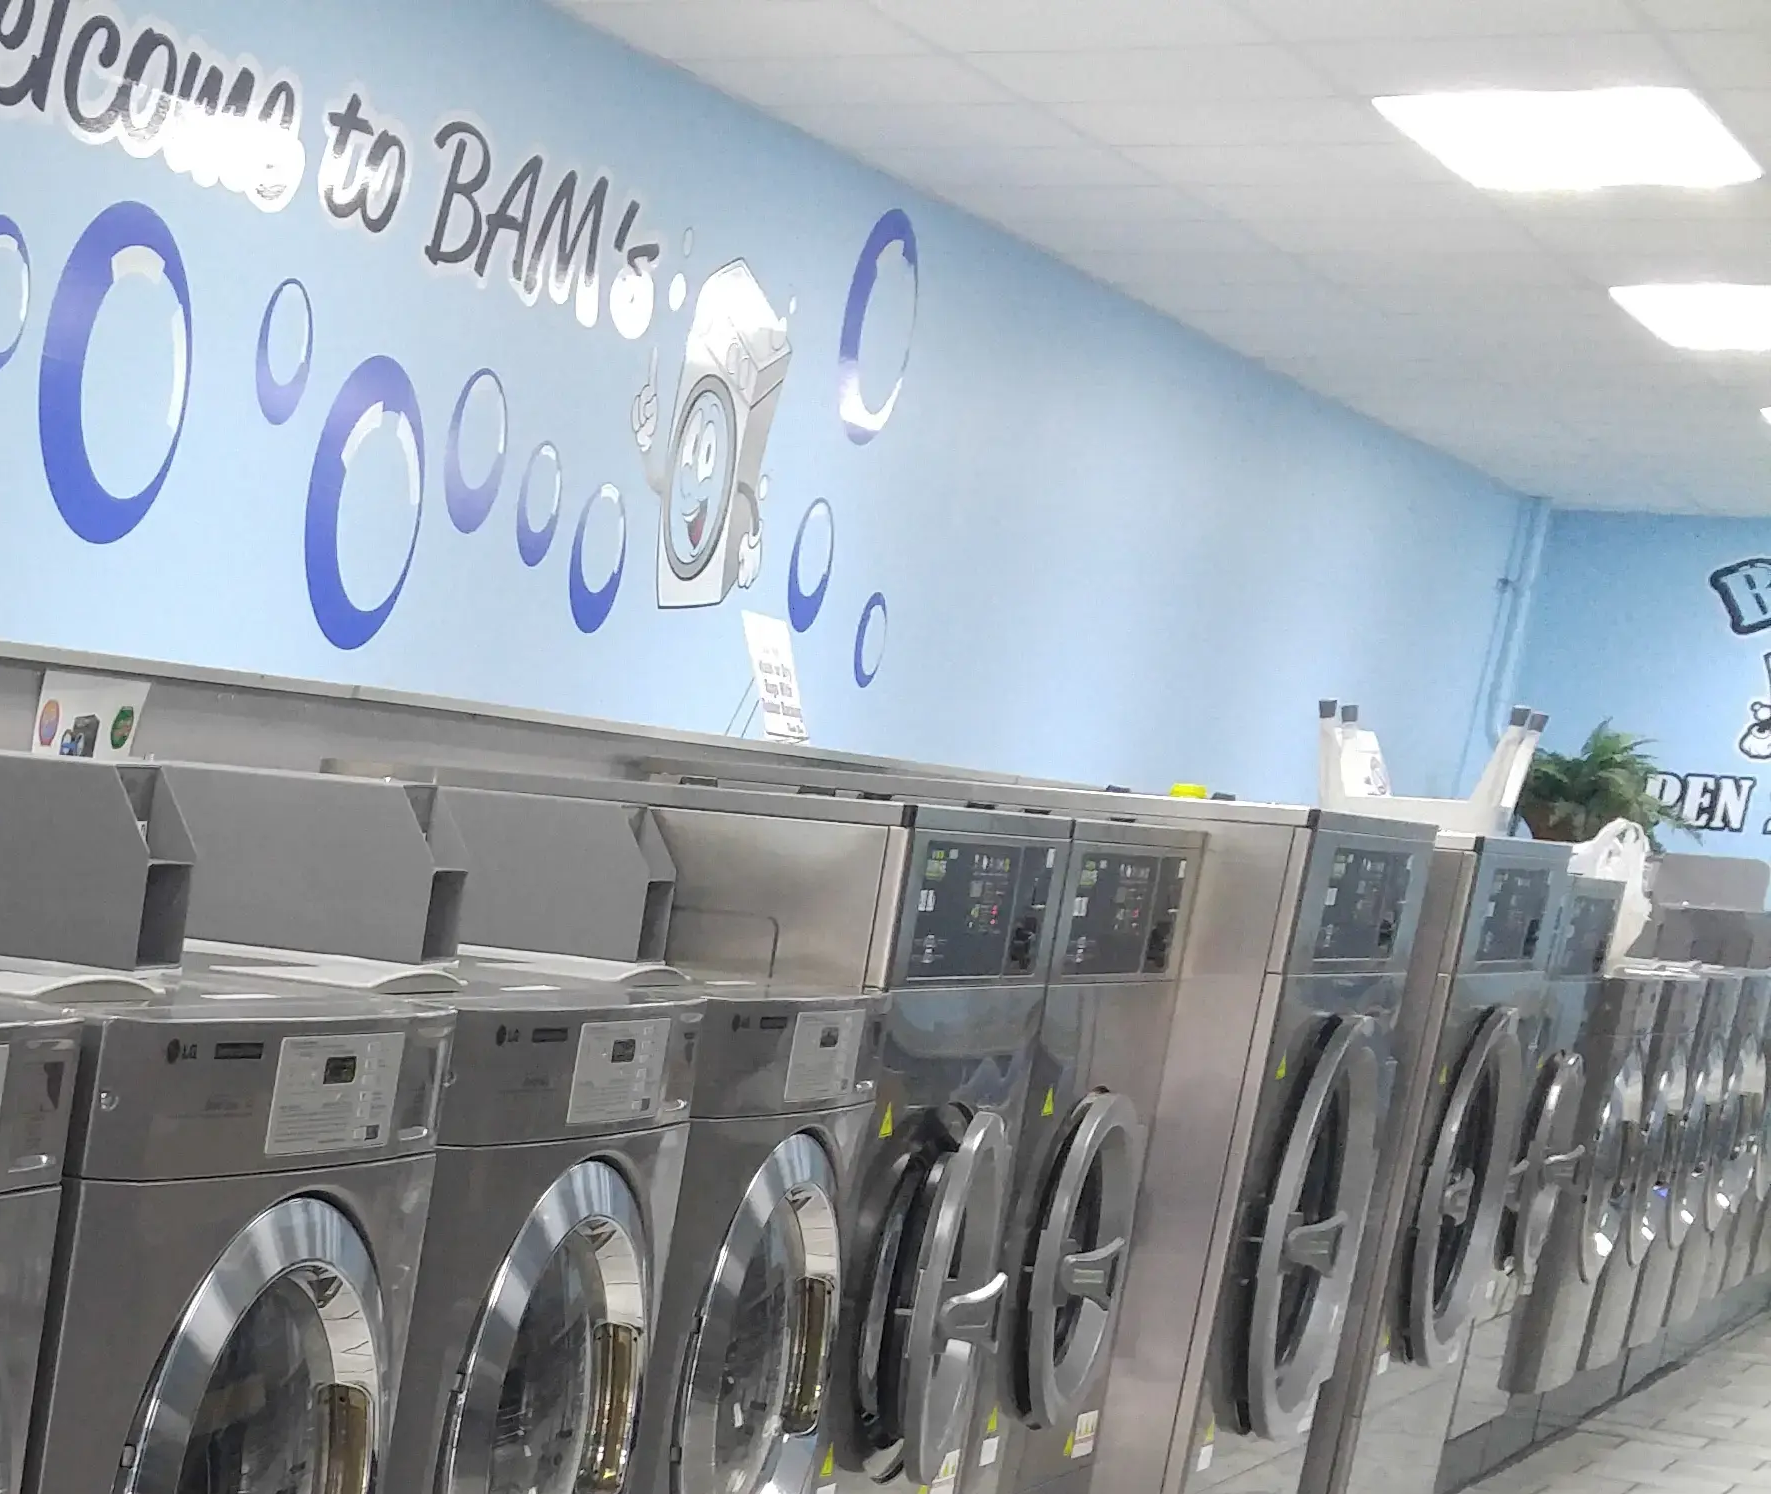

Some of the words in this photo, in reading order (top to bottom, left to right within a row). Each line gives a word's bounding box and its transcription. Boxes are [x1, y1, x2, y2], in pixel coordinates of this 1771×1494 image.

[322, 93, 408, 234] to
[424, 121, 661, 302] BAM's
[1645, 771, 1757, 833] PEN
